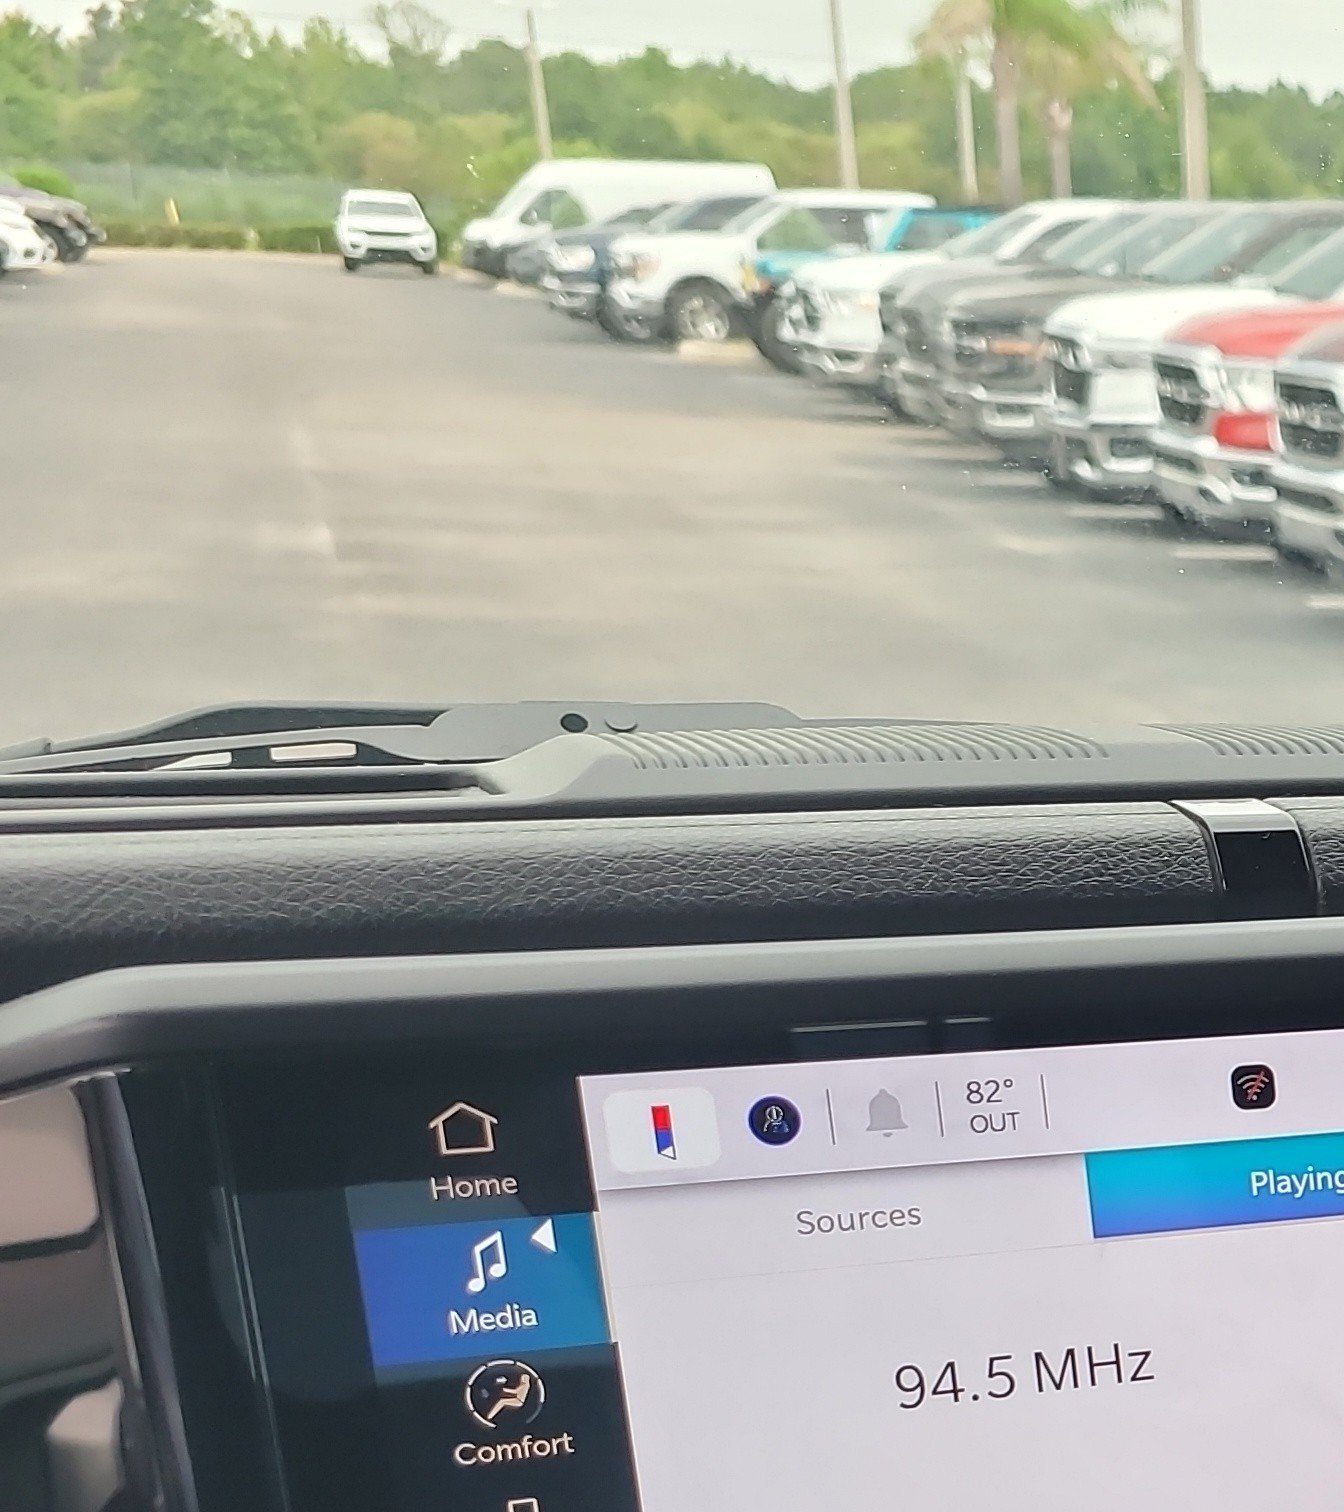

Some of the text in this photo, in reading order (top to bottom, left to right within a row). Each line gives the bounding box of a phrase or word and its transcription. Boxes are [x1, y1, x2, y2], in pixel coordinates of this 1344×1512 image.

[965, 1078, 1014, 1107] 82°
[970, 1109, 1020, 1136] OUT
[430, 1172, 519, 1200] Home
[796, 1202, 923, 1237] Sources
[448, 1303, 538, 1336] Media
[894, 1343, 1156, 1411] 94.5 MHz
[454, 1430, 575, 1466] Comfort
